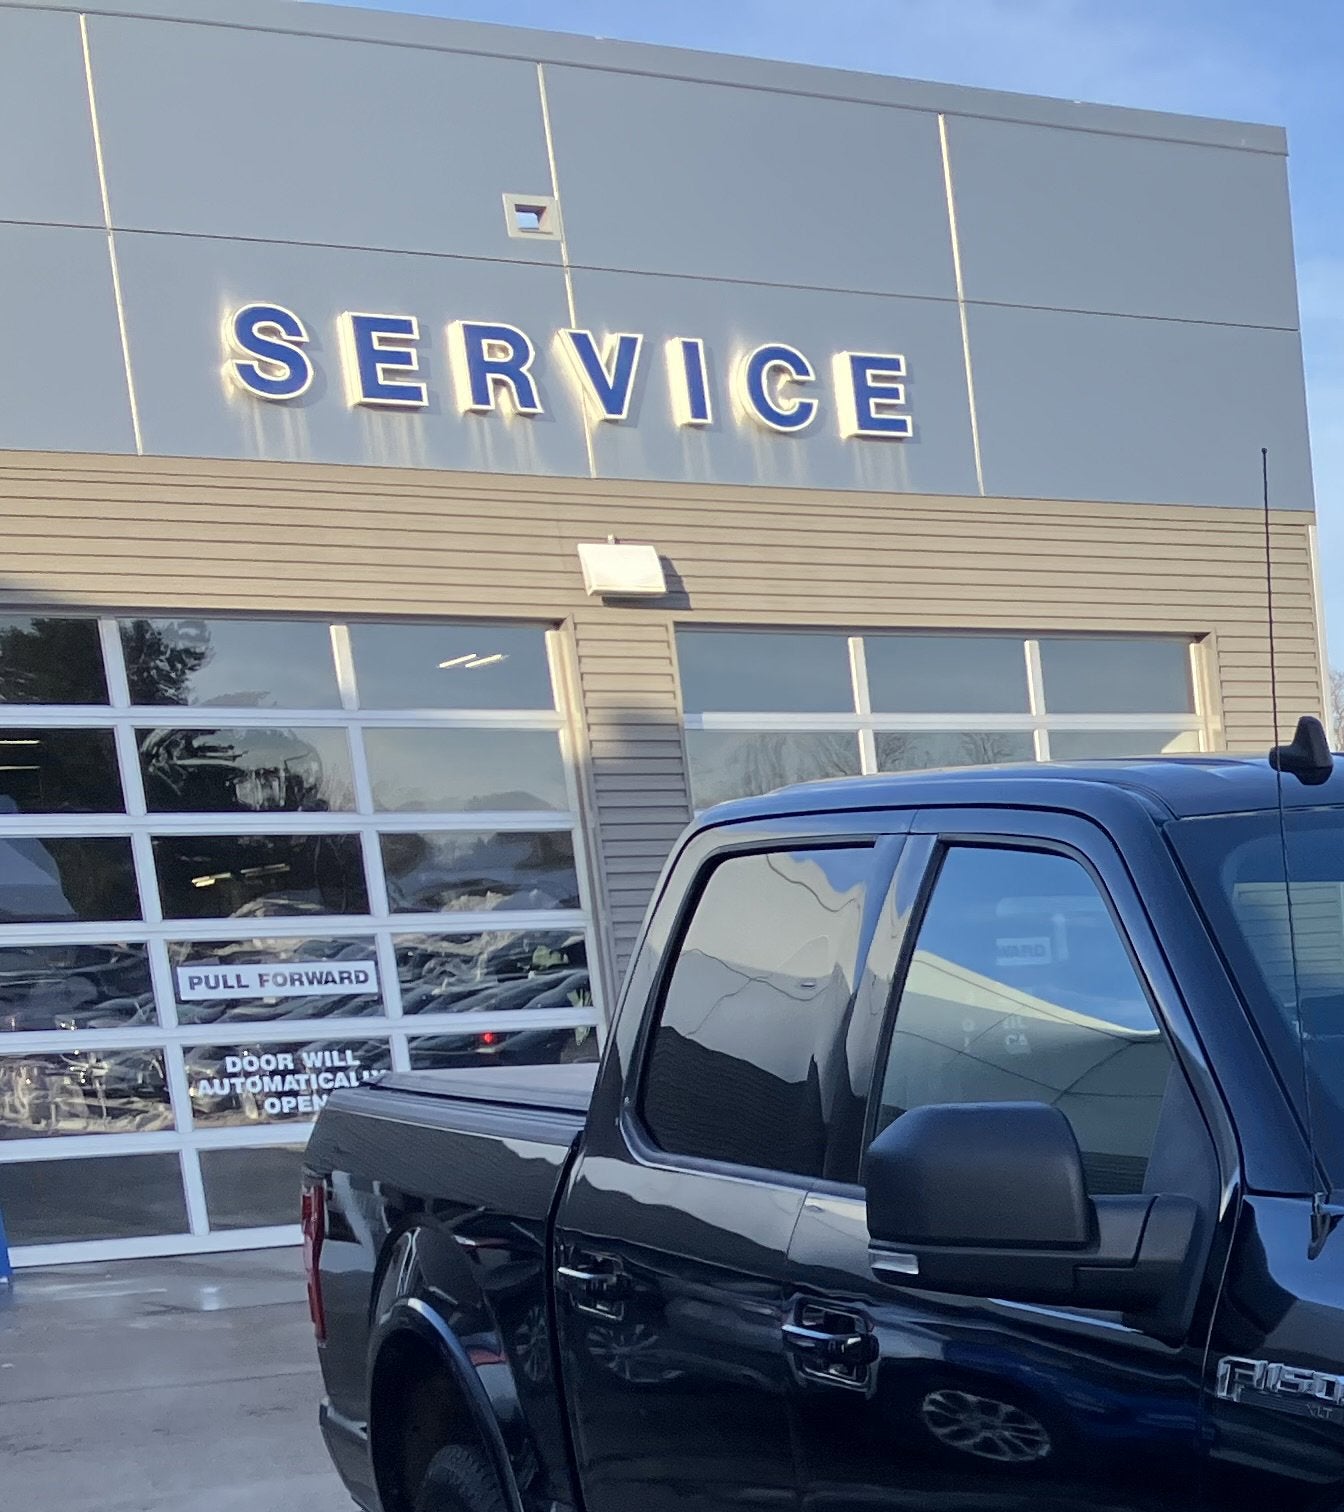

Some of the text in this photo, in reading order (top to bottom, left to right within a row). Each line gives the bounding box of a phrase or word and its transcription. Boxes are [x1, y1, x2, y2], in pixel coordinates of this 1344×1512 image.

[226, 303, 912, 437] SERVICE
[188, 969, 370, 991] PULL FORWARD
[225, 1050, 361, 1073] DOOR WILL
[264, 1093, 329, 1114] OPEN
